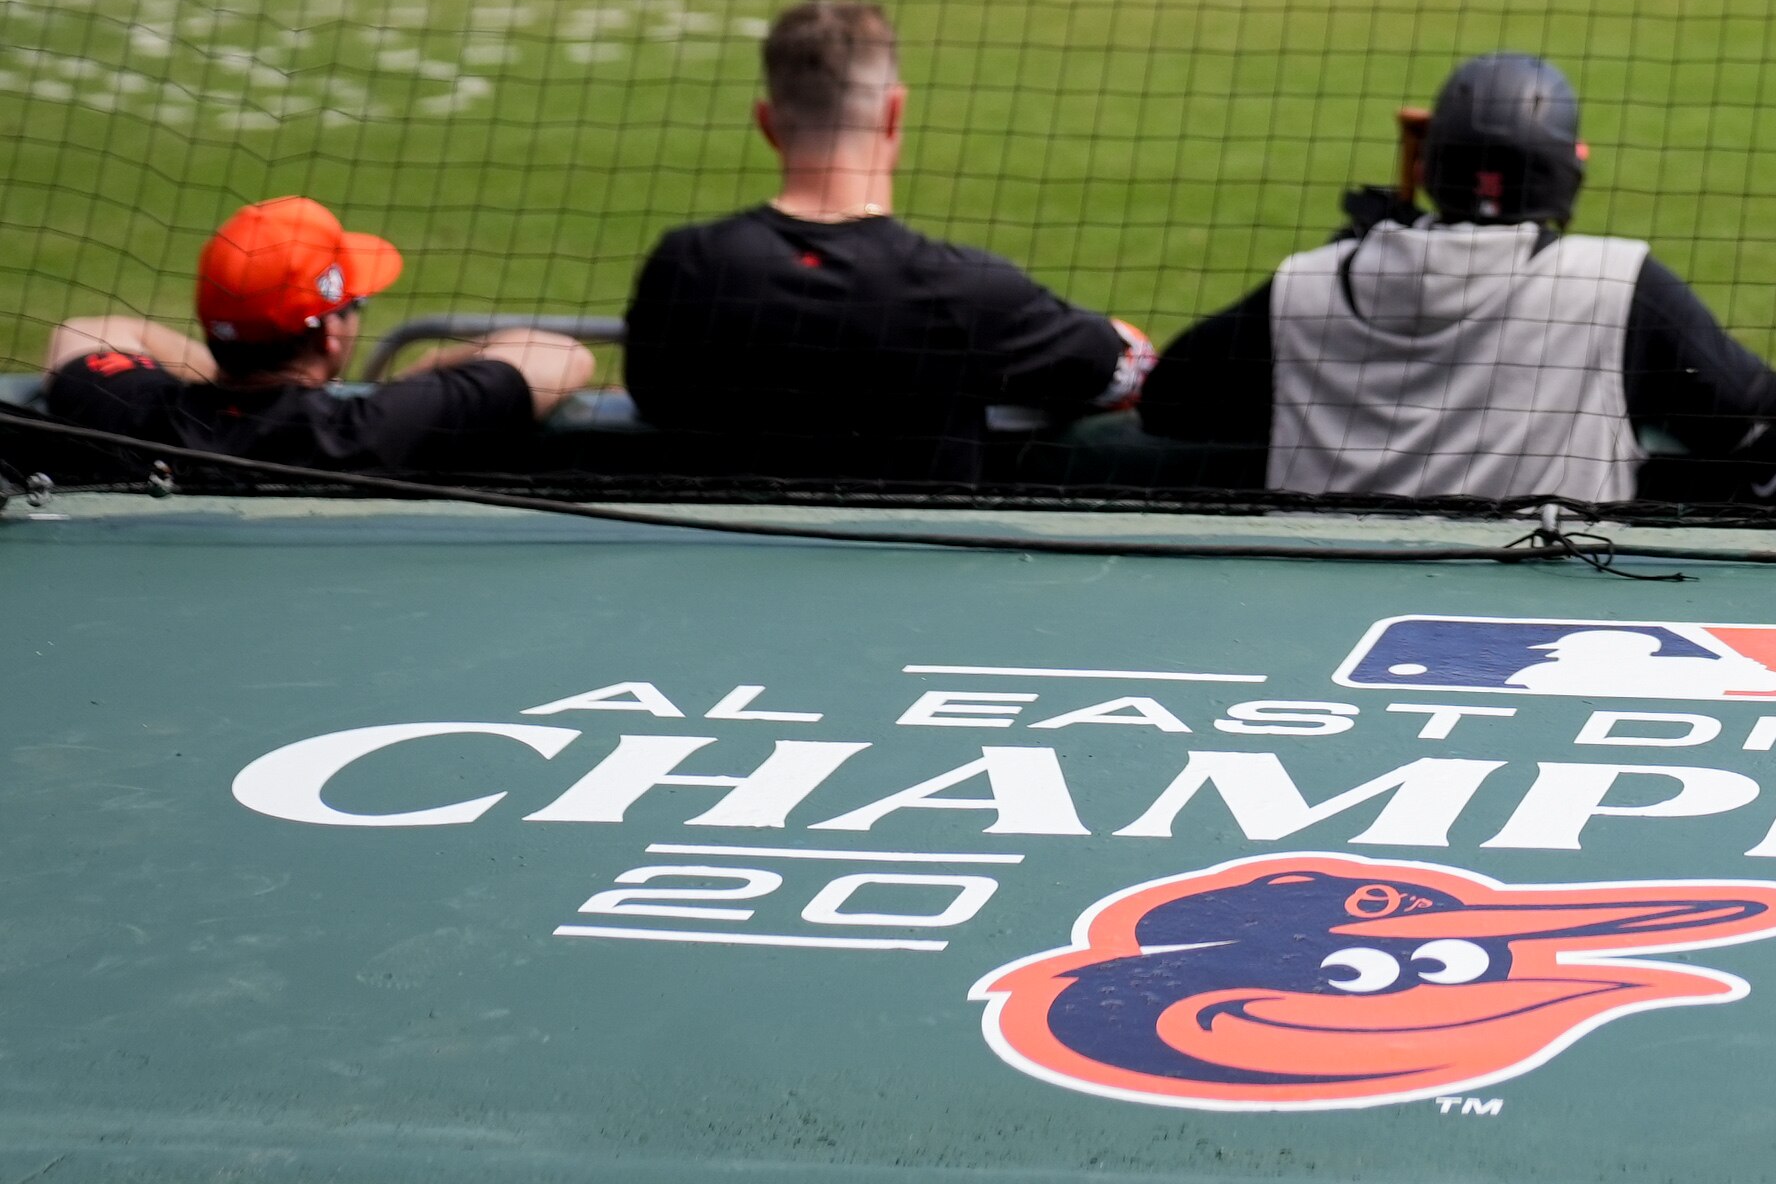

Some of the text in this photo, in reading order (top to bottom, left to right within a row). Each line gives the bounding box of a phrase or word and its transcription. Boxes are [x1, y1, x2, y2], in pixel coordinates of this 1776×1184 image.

[520, 681, 824, 722] AL
[895, 690, 1518, 741] EAST
[577, 865, 999, 927] 20
[1435, 1096, 1504, 1116] TM
